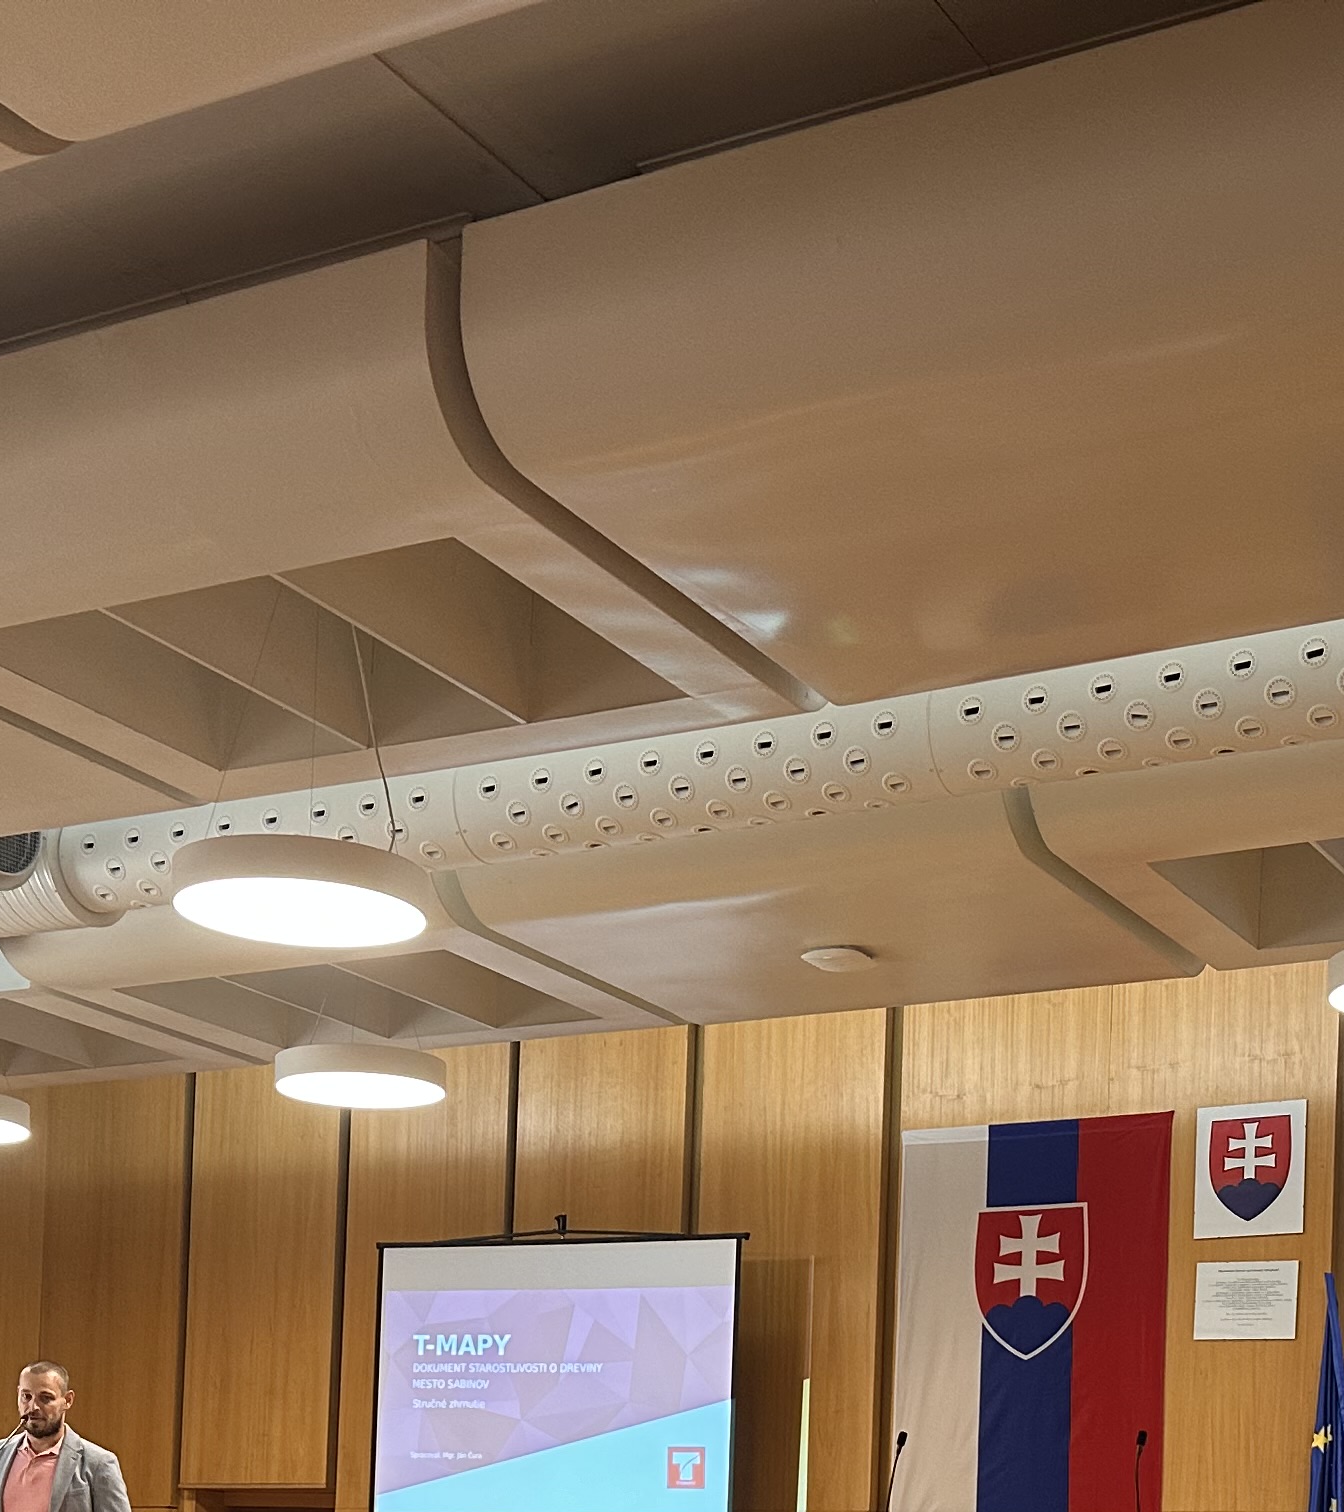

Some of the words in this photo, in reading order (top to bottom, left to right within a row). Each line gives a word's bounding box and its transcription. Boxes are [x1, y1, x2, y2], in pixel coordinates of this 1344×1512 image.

[412, 1333, 512, 1356] T-MAPY
[412, 1362, 466, 1374] DOKUMENT
[468, 1362, 547, 1374] STAROSTLIVOSTI
[548, 1362, 558, 1374] O
[560, 1362, 604, 1374] DREVINY
[412, 1379, 446, 1390] MESTO
[447, 1379, 490, 1390] SABINOV
[412, 1398, 447, 1409] Stručné
